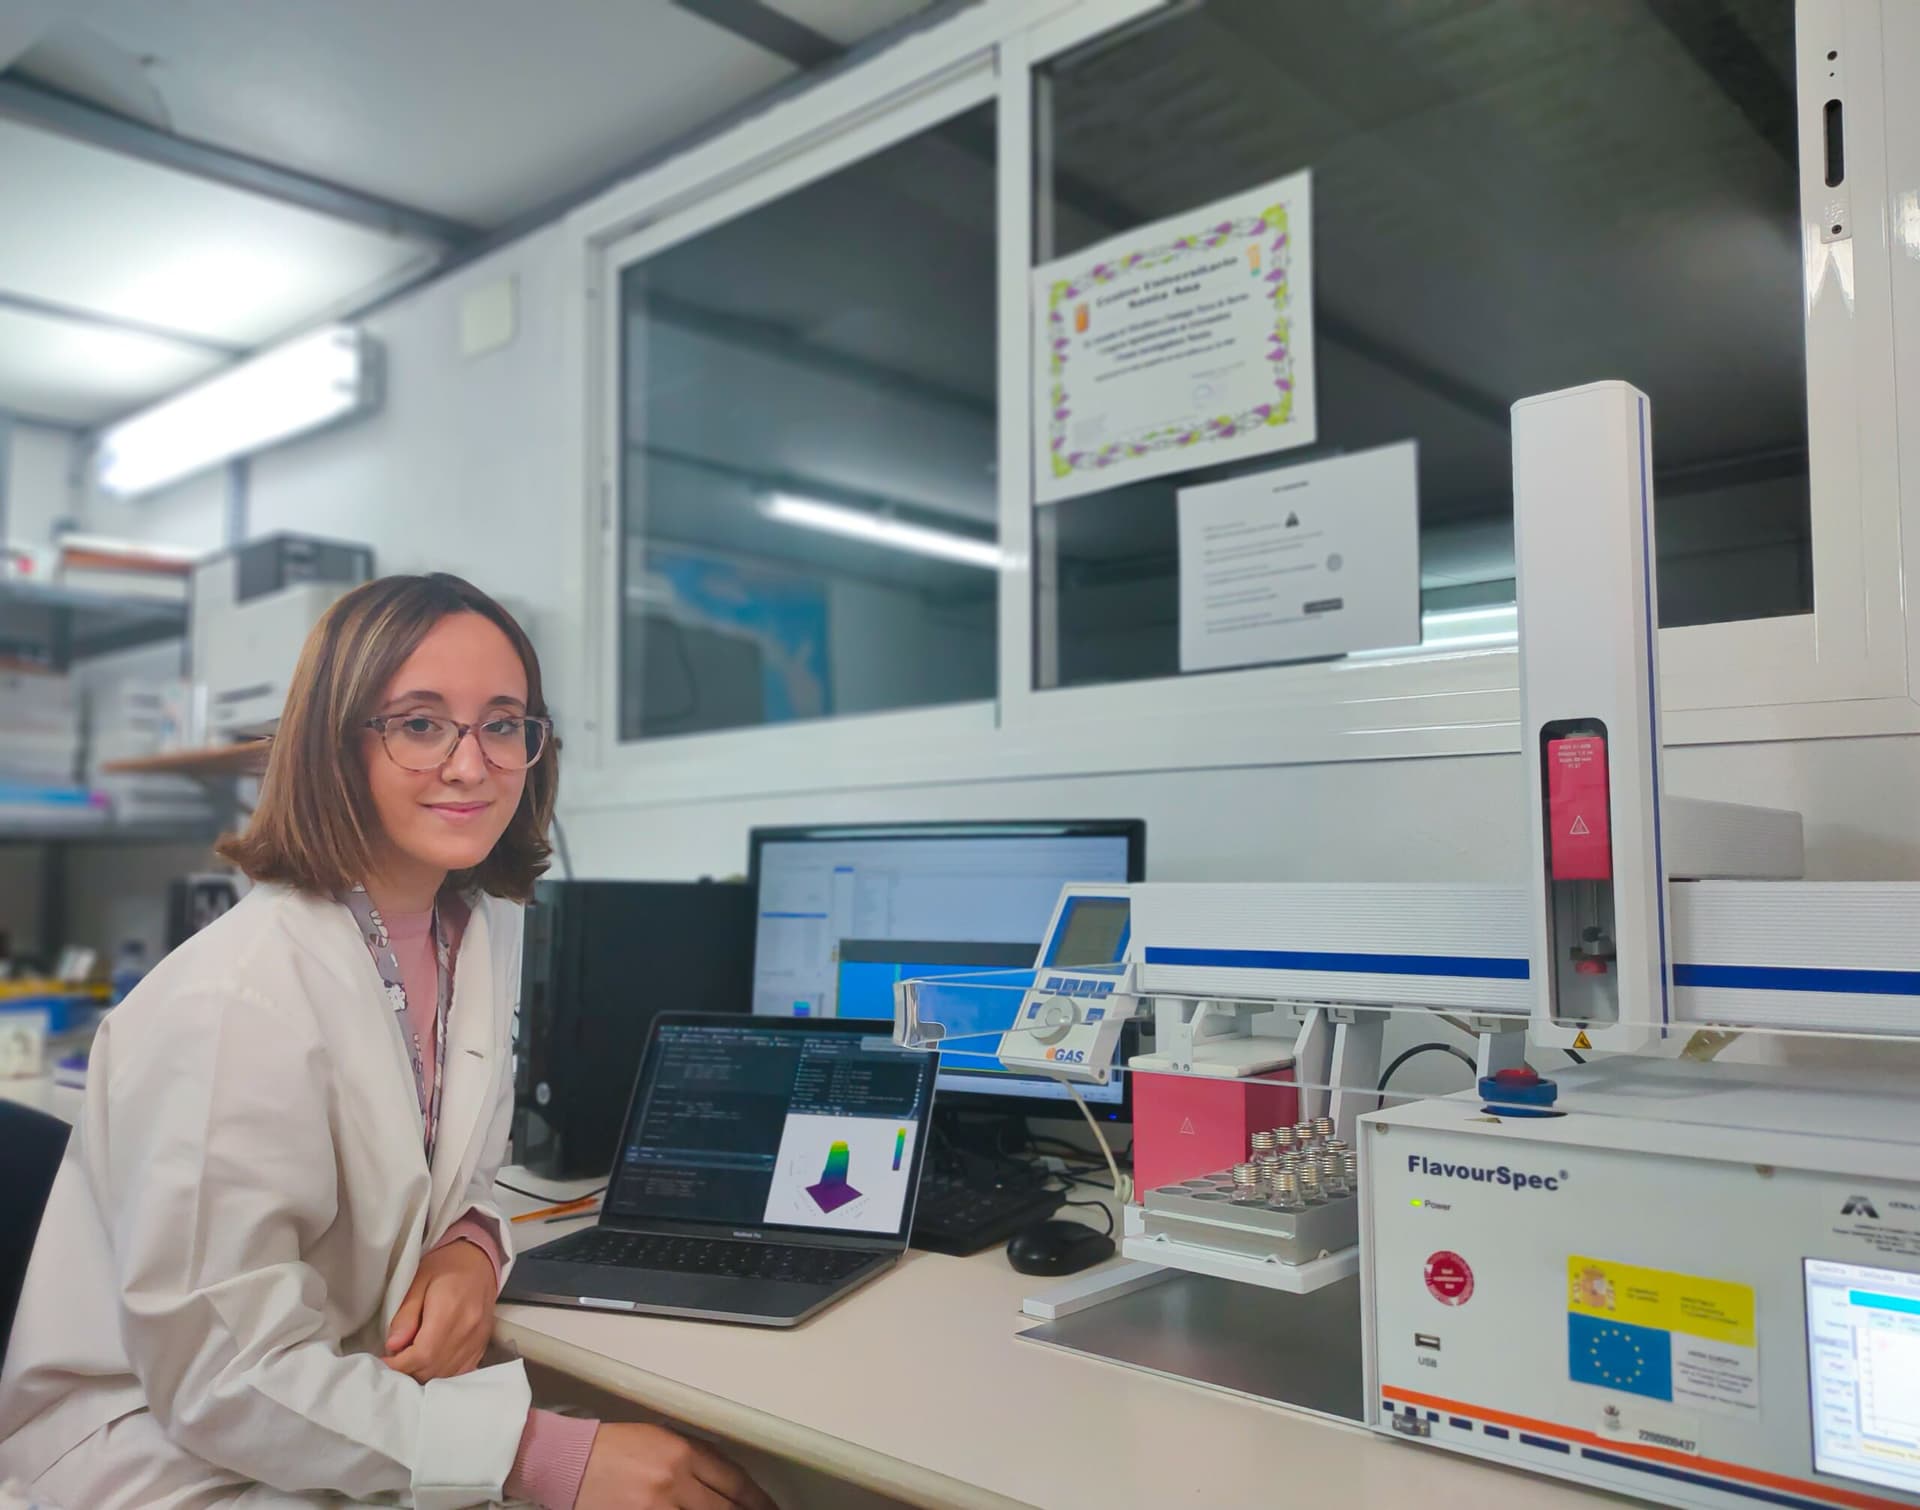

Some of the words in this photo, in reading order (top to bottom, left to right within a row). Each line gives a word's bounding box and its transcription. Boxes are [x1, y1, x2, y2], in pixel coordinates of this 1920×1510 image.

[1055, 1048, 1085, 1063] GAS
[1424, 1199, 1451, 1212] Power
[1418, 1356, 1438, 1368] USB
